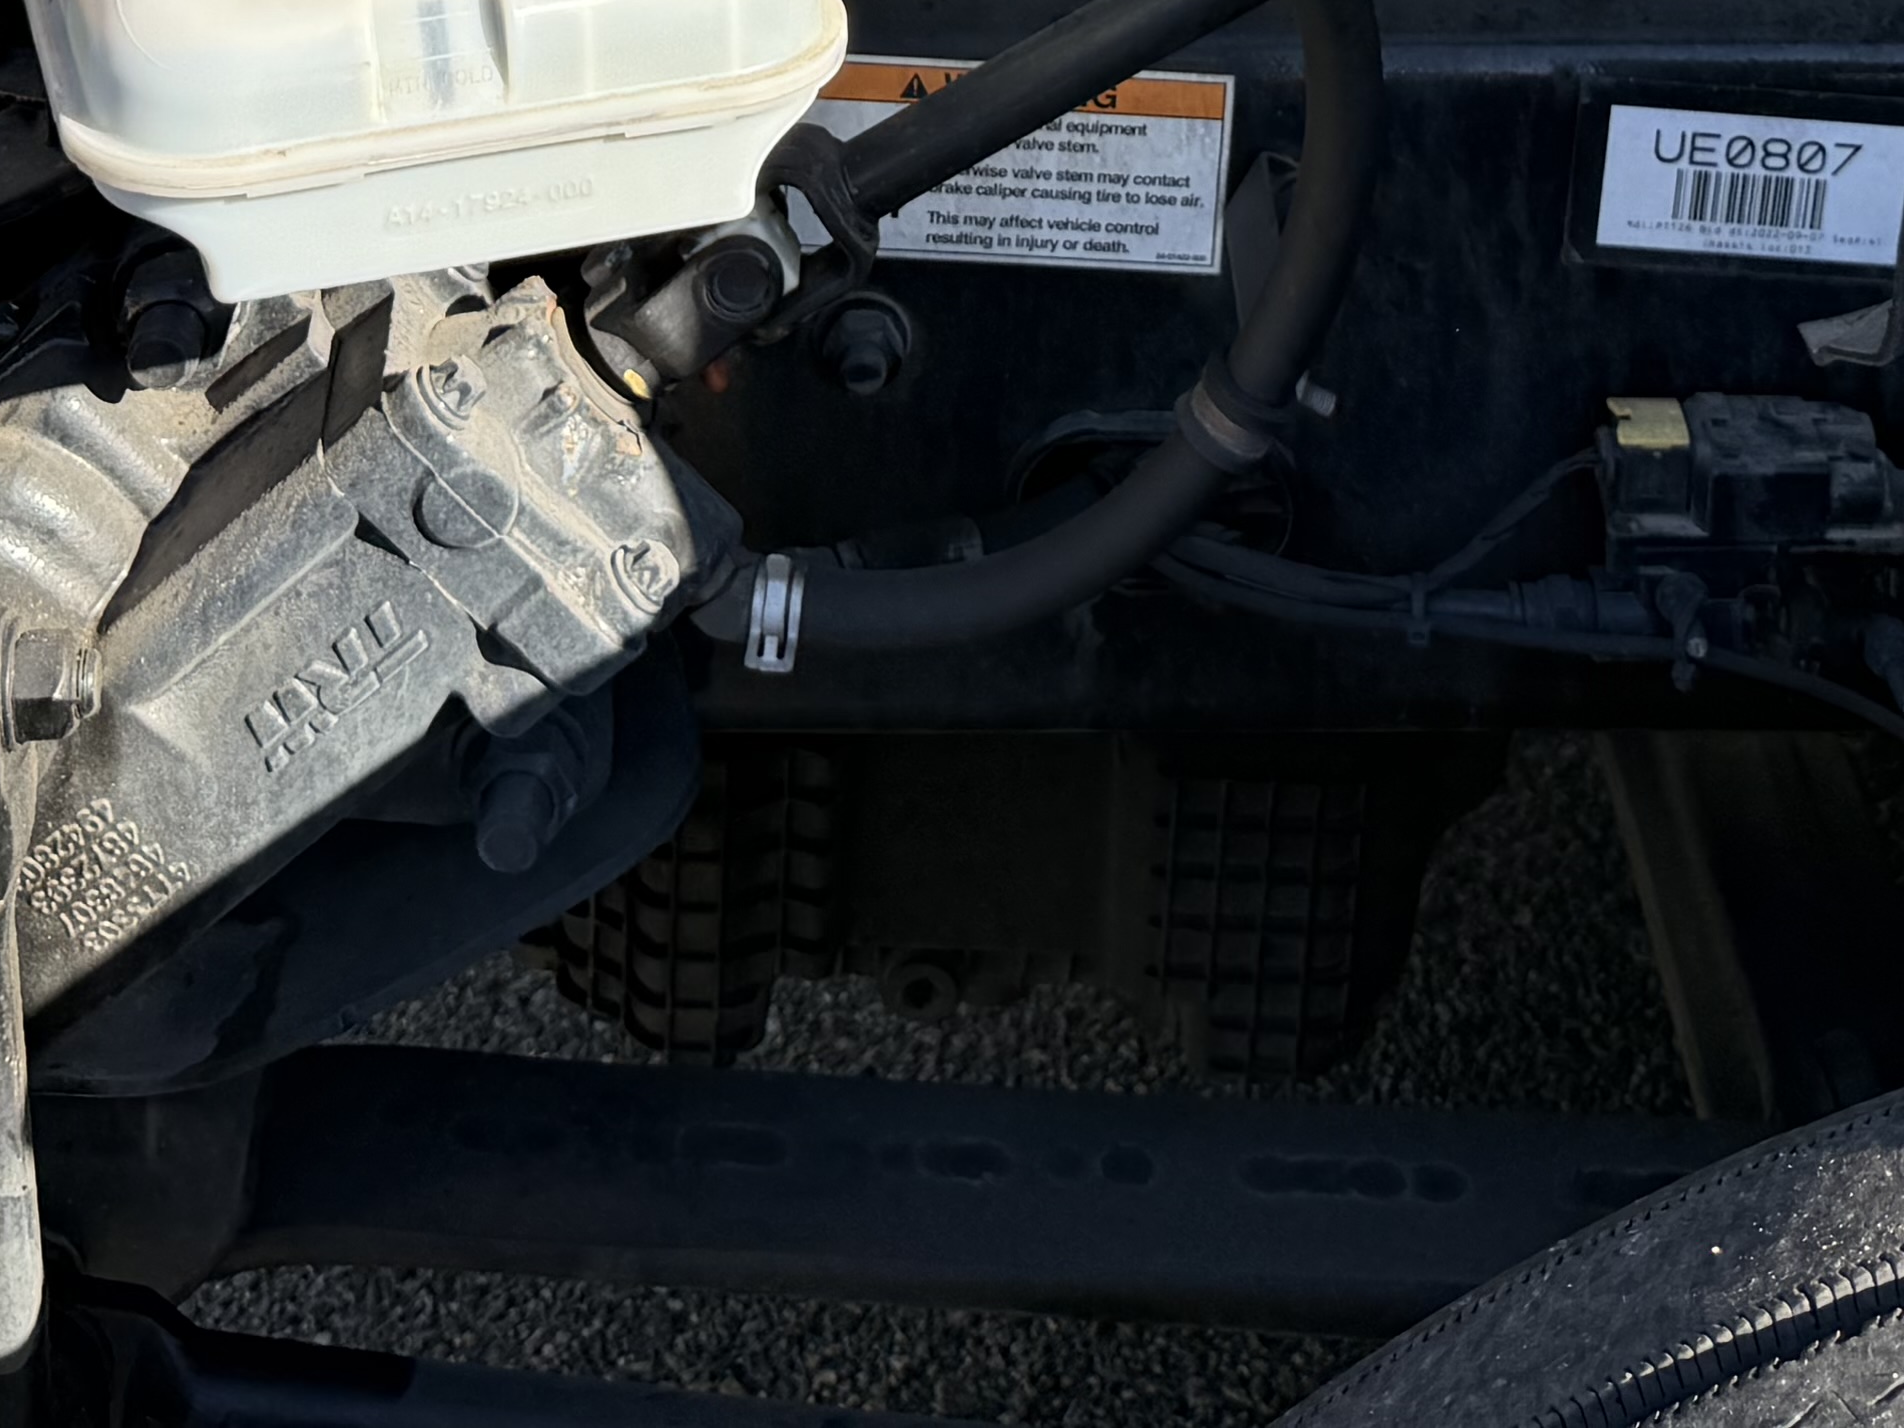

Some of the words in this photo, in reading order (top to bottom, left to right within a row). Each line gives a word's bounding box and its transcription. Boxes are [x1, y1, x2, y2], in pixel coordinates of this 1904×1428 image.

[1067, 121, 1147, 137] equipment
[1015, 140, 1054, 152] valve
[1058, 142, 1099, 154] stem.
[1655, 129, 1864, 176] UE0807
[1012, 167, 1052, 180] valve
[1056, 170, 1093, 182] stem
[1097, 172, 1129, 187] may
[1133, 174, 1190, 187] contact
[976, 183, 1027, 199] caliper
[1031, 187, 1092, 203] causing
[1095, 188, 1121, 202] tire
[1125, 191, 1140, 203] to
[1145, 192, 1176, 205] lose
[1181, 194, 1204, 208] air.
[928, 211, 959, 225] This
[963, 215, 996, 230] may
[999, 216, 1044, 229] affect
[1047, 218, 1101, 232] vehicle
[1105, 221, 1160, 235] control
[926, 232, 993, 249] resulting
[997, 234, 1011, 247] in
[1016, 235, 1059, 253] injury
[1063, 239, 1079, 250] or
[1083, 239, 1130, 253] death.
[244, 601, 430, 772] TRW
